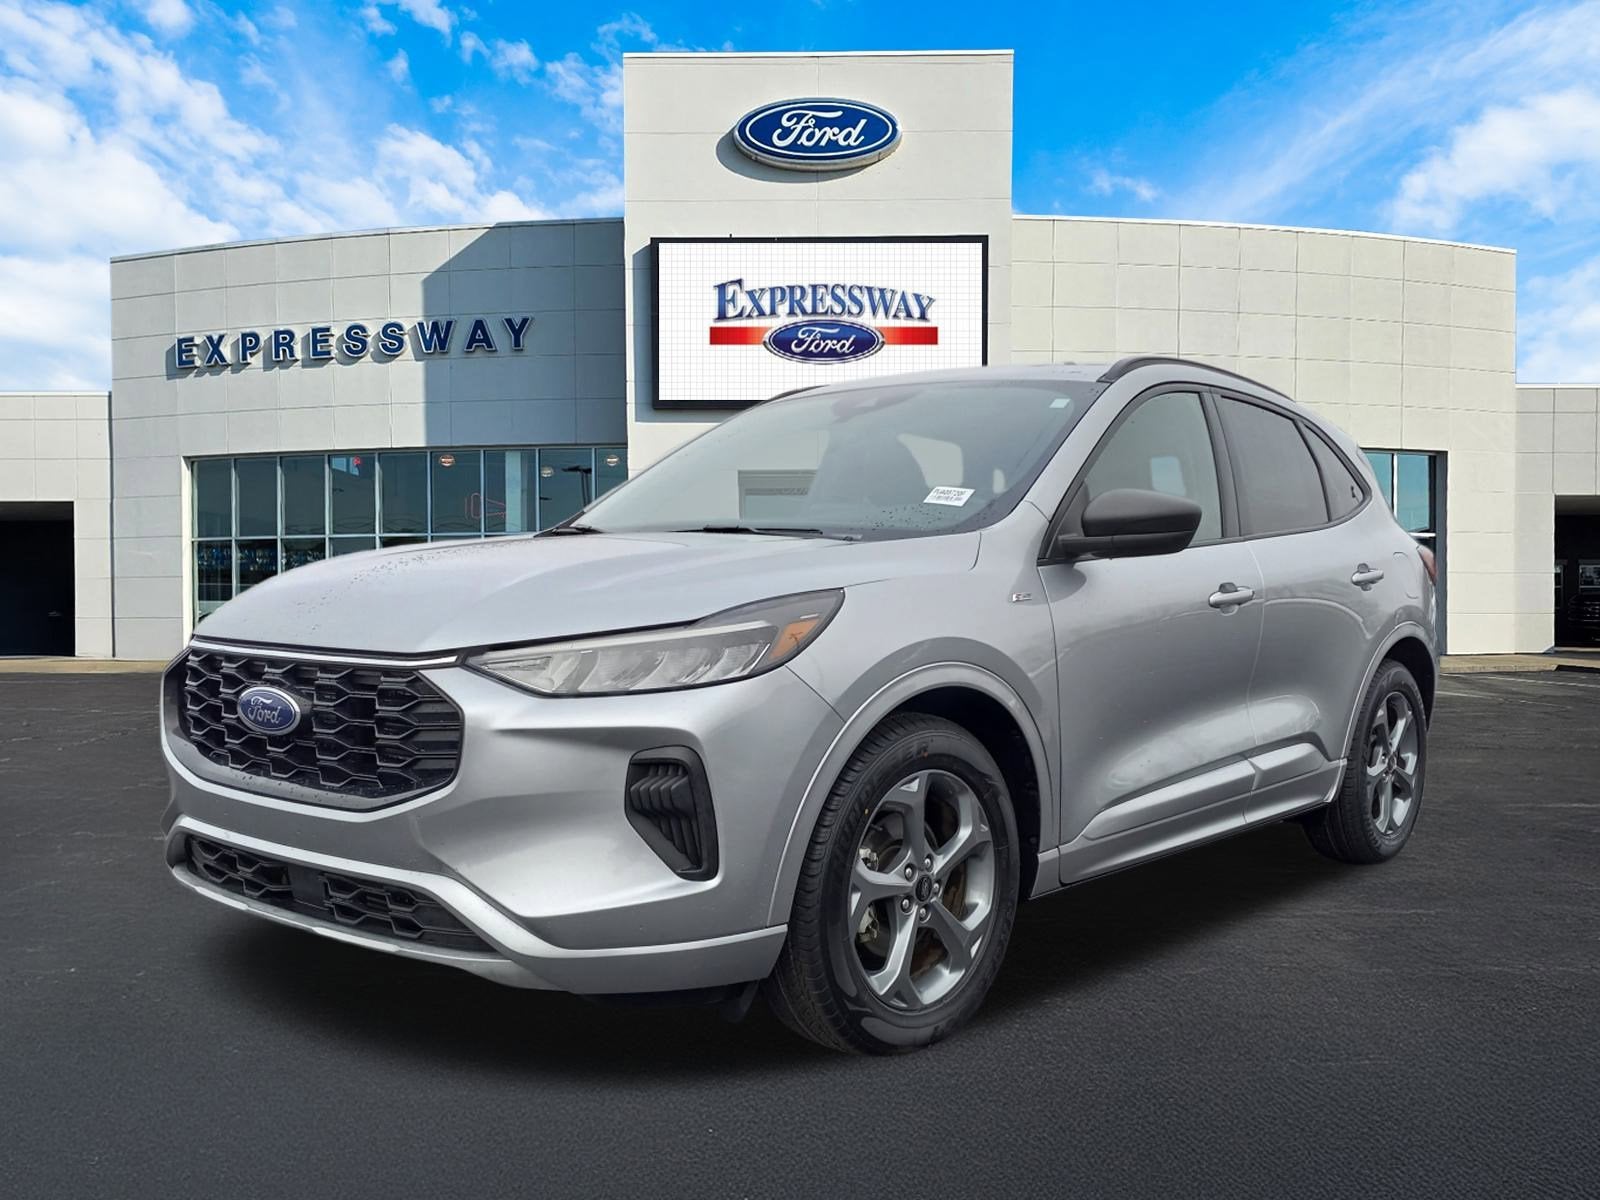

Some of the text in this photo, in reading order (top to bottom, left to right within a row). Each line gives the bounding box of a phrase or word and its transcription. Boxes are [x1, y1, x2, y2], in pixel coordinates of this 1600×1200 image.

[772, 109, 868, 148] Ford
[713, 278, 936, 322] EXPRESSWAY
[175, 316, 533, 369] EXPRESSWAY
[791, 326, 855, 355] Ford
[247, 695, 282, 724] Ford
